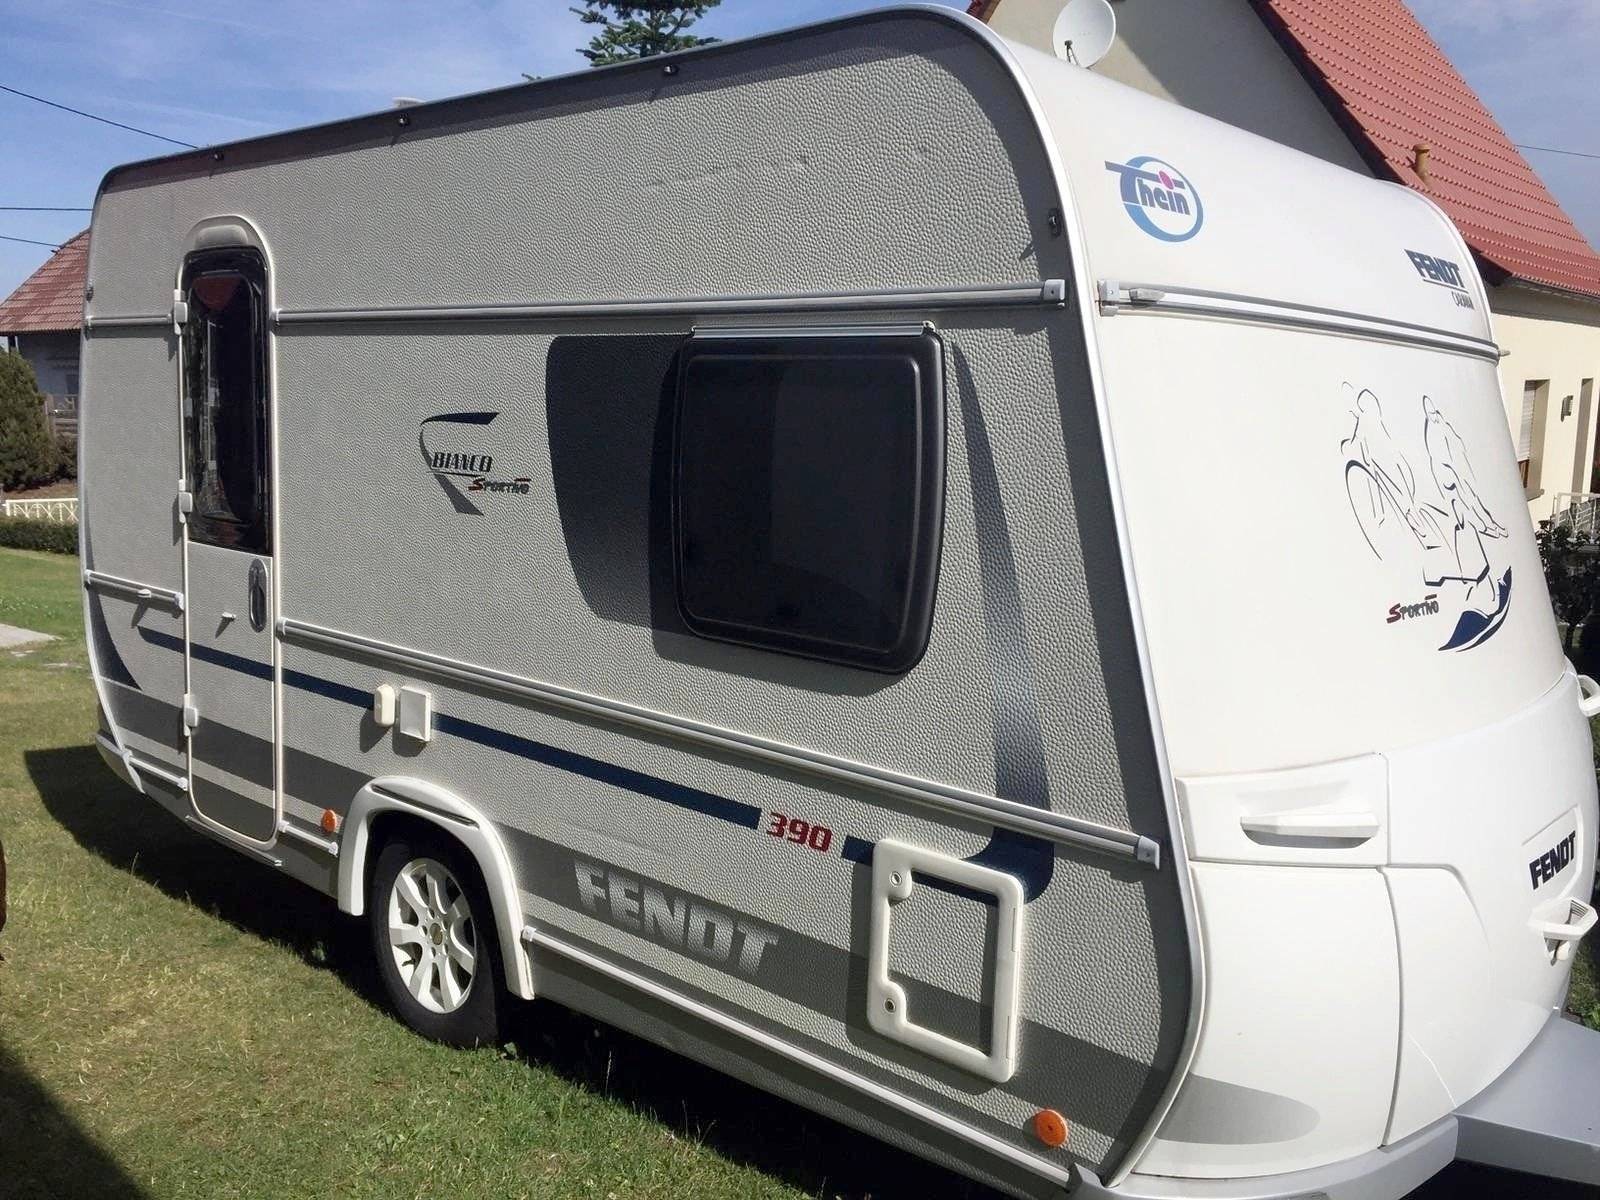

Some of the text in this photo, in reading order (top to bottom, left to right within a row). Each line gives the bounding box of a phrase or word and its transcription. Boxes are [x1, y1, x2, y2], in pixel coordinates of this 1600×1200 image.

[1104, 160, 1191, 216] Thein
[1404, 248, 1465, 288] FENDT
[432, 451, 493, 473] BIANCO
[766, 811, 834, 852] 390
[1529, 830, 1576, 890] FENDT
[574, 859, 780, 976] FENDT
